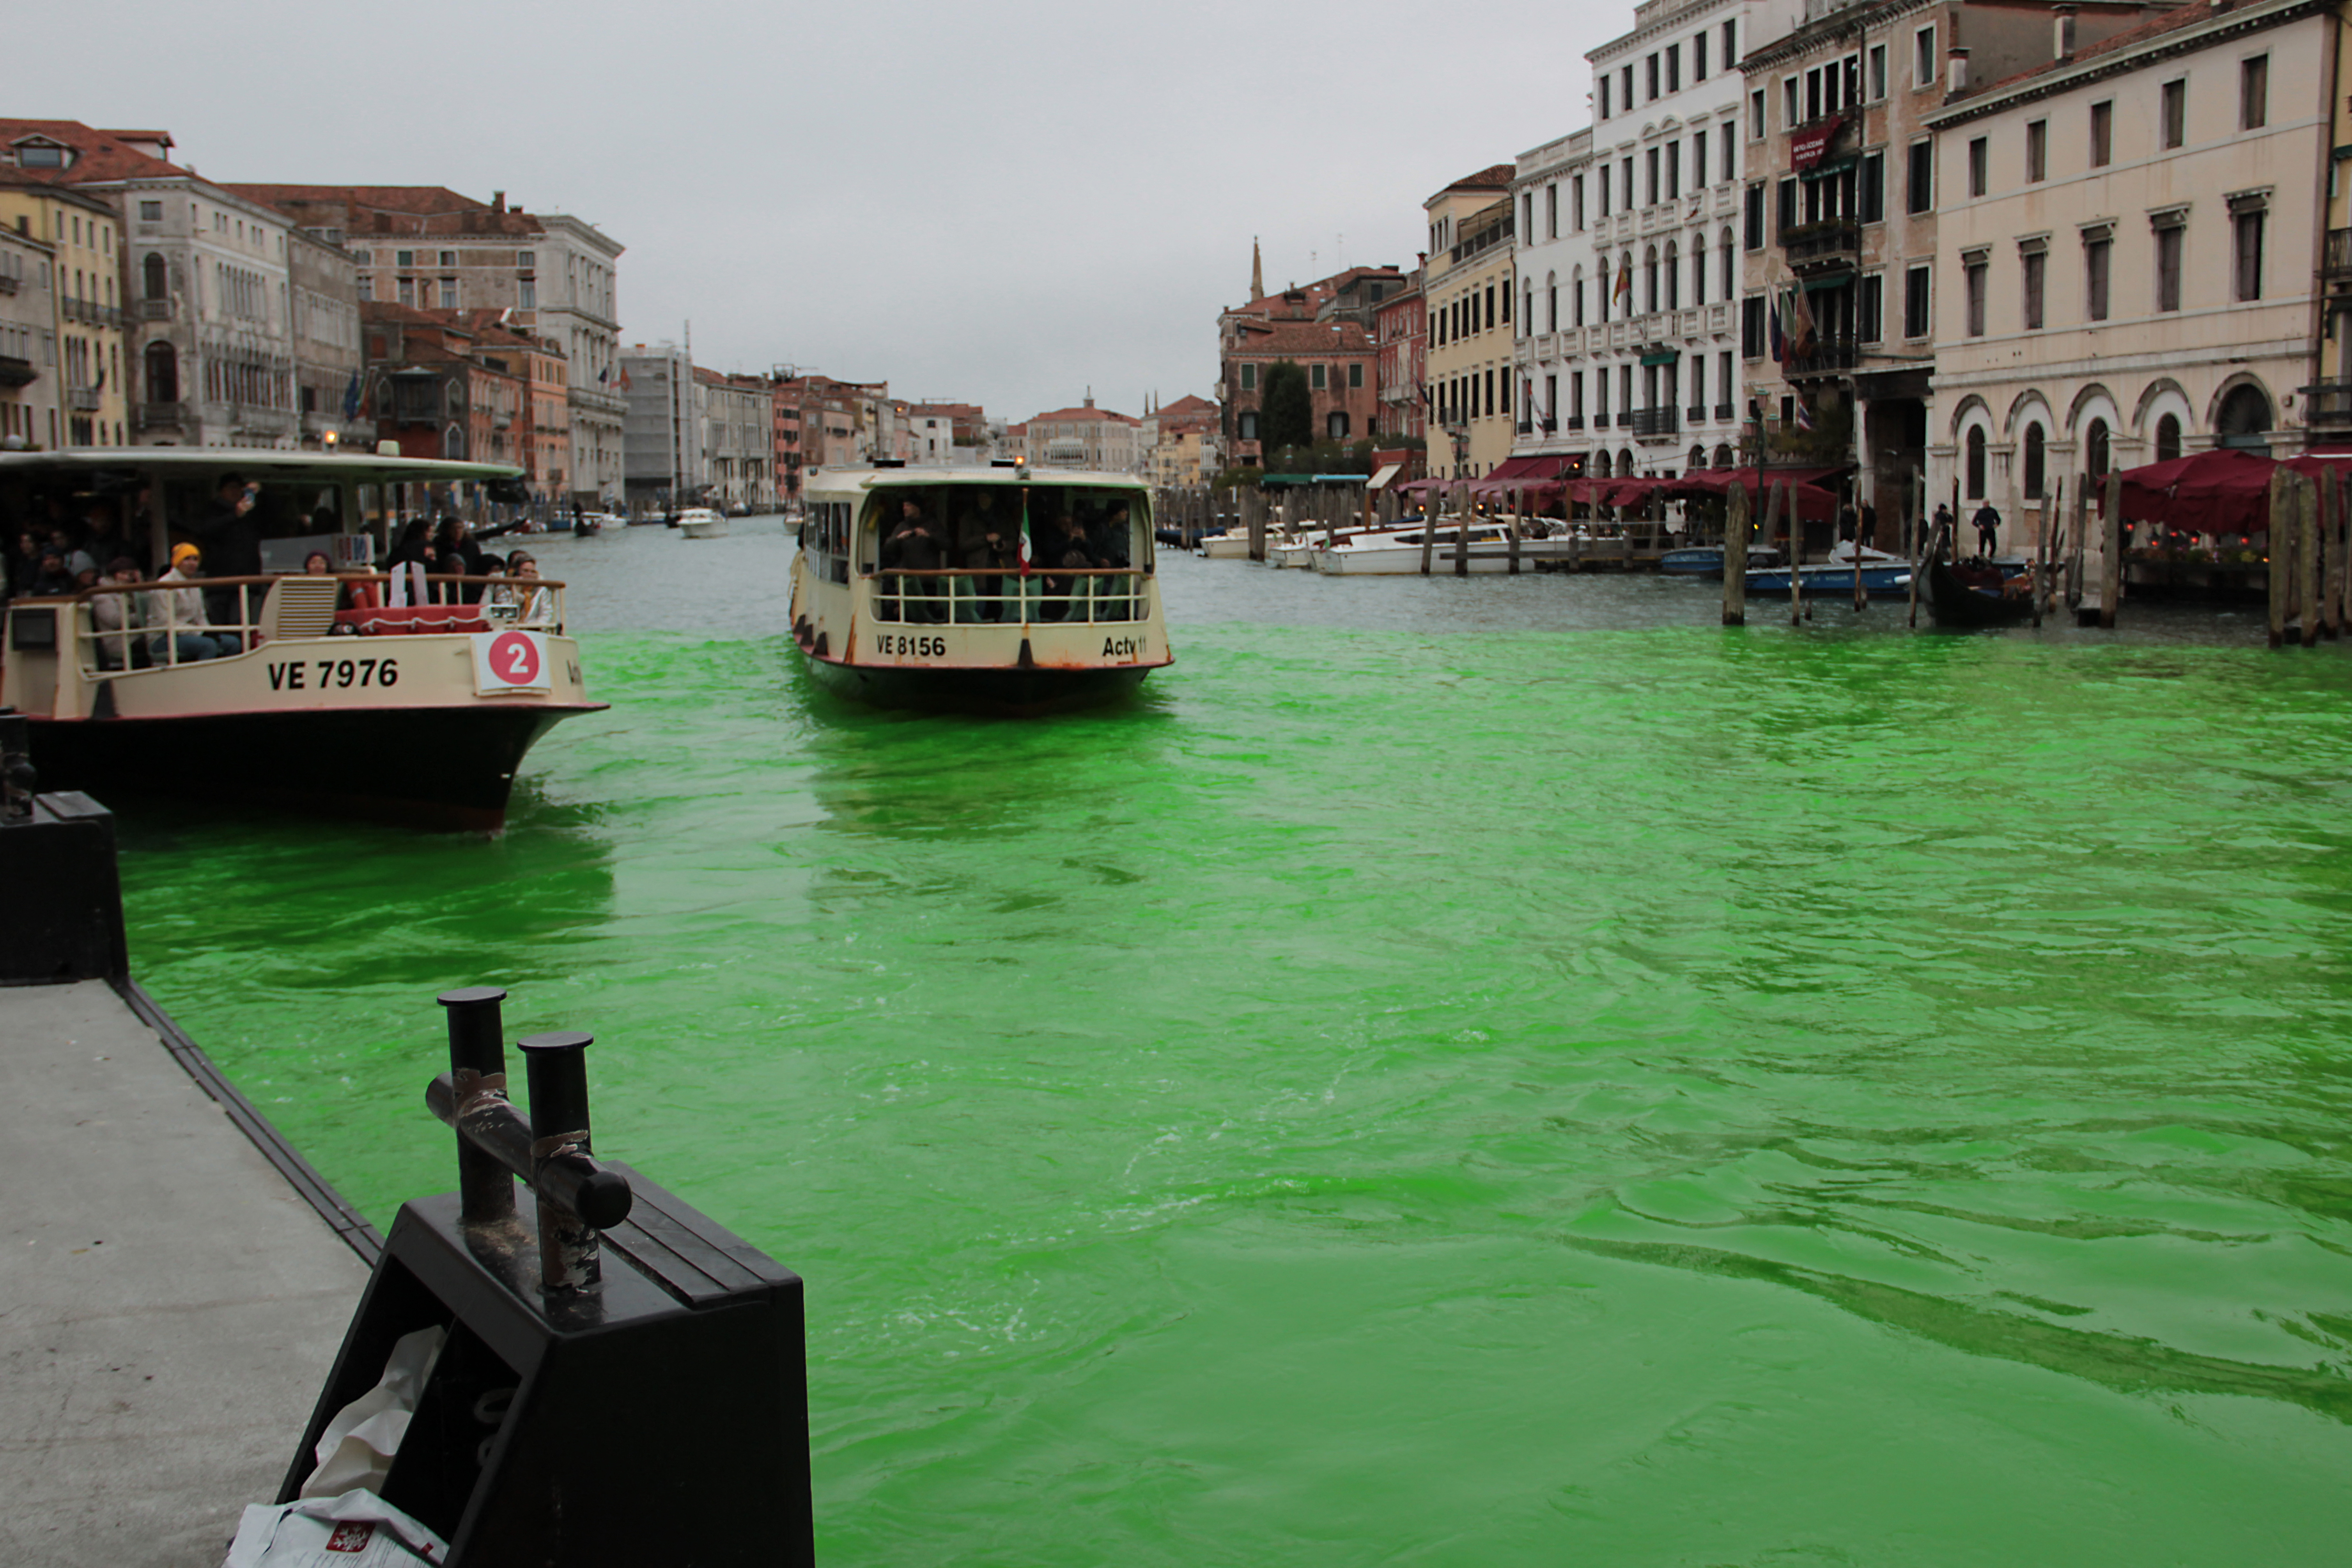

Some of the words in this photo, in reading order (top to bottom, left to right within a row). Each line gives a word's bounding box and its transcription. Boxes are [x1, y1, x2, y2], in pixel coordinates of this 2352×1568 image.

[507, 643, 528, 674] 2
[877, 635, 893, 654] VE
[898, 636, 946, 656] 8156
[1102, 637, 1136, 656] Actv
[268, 662, 306, 690] VE
[318, 659, 398, 688] 7976
